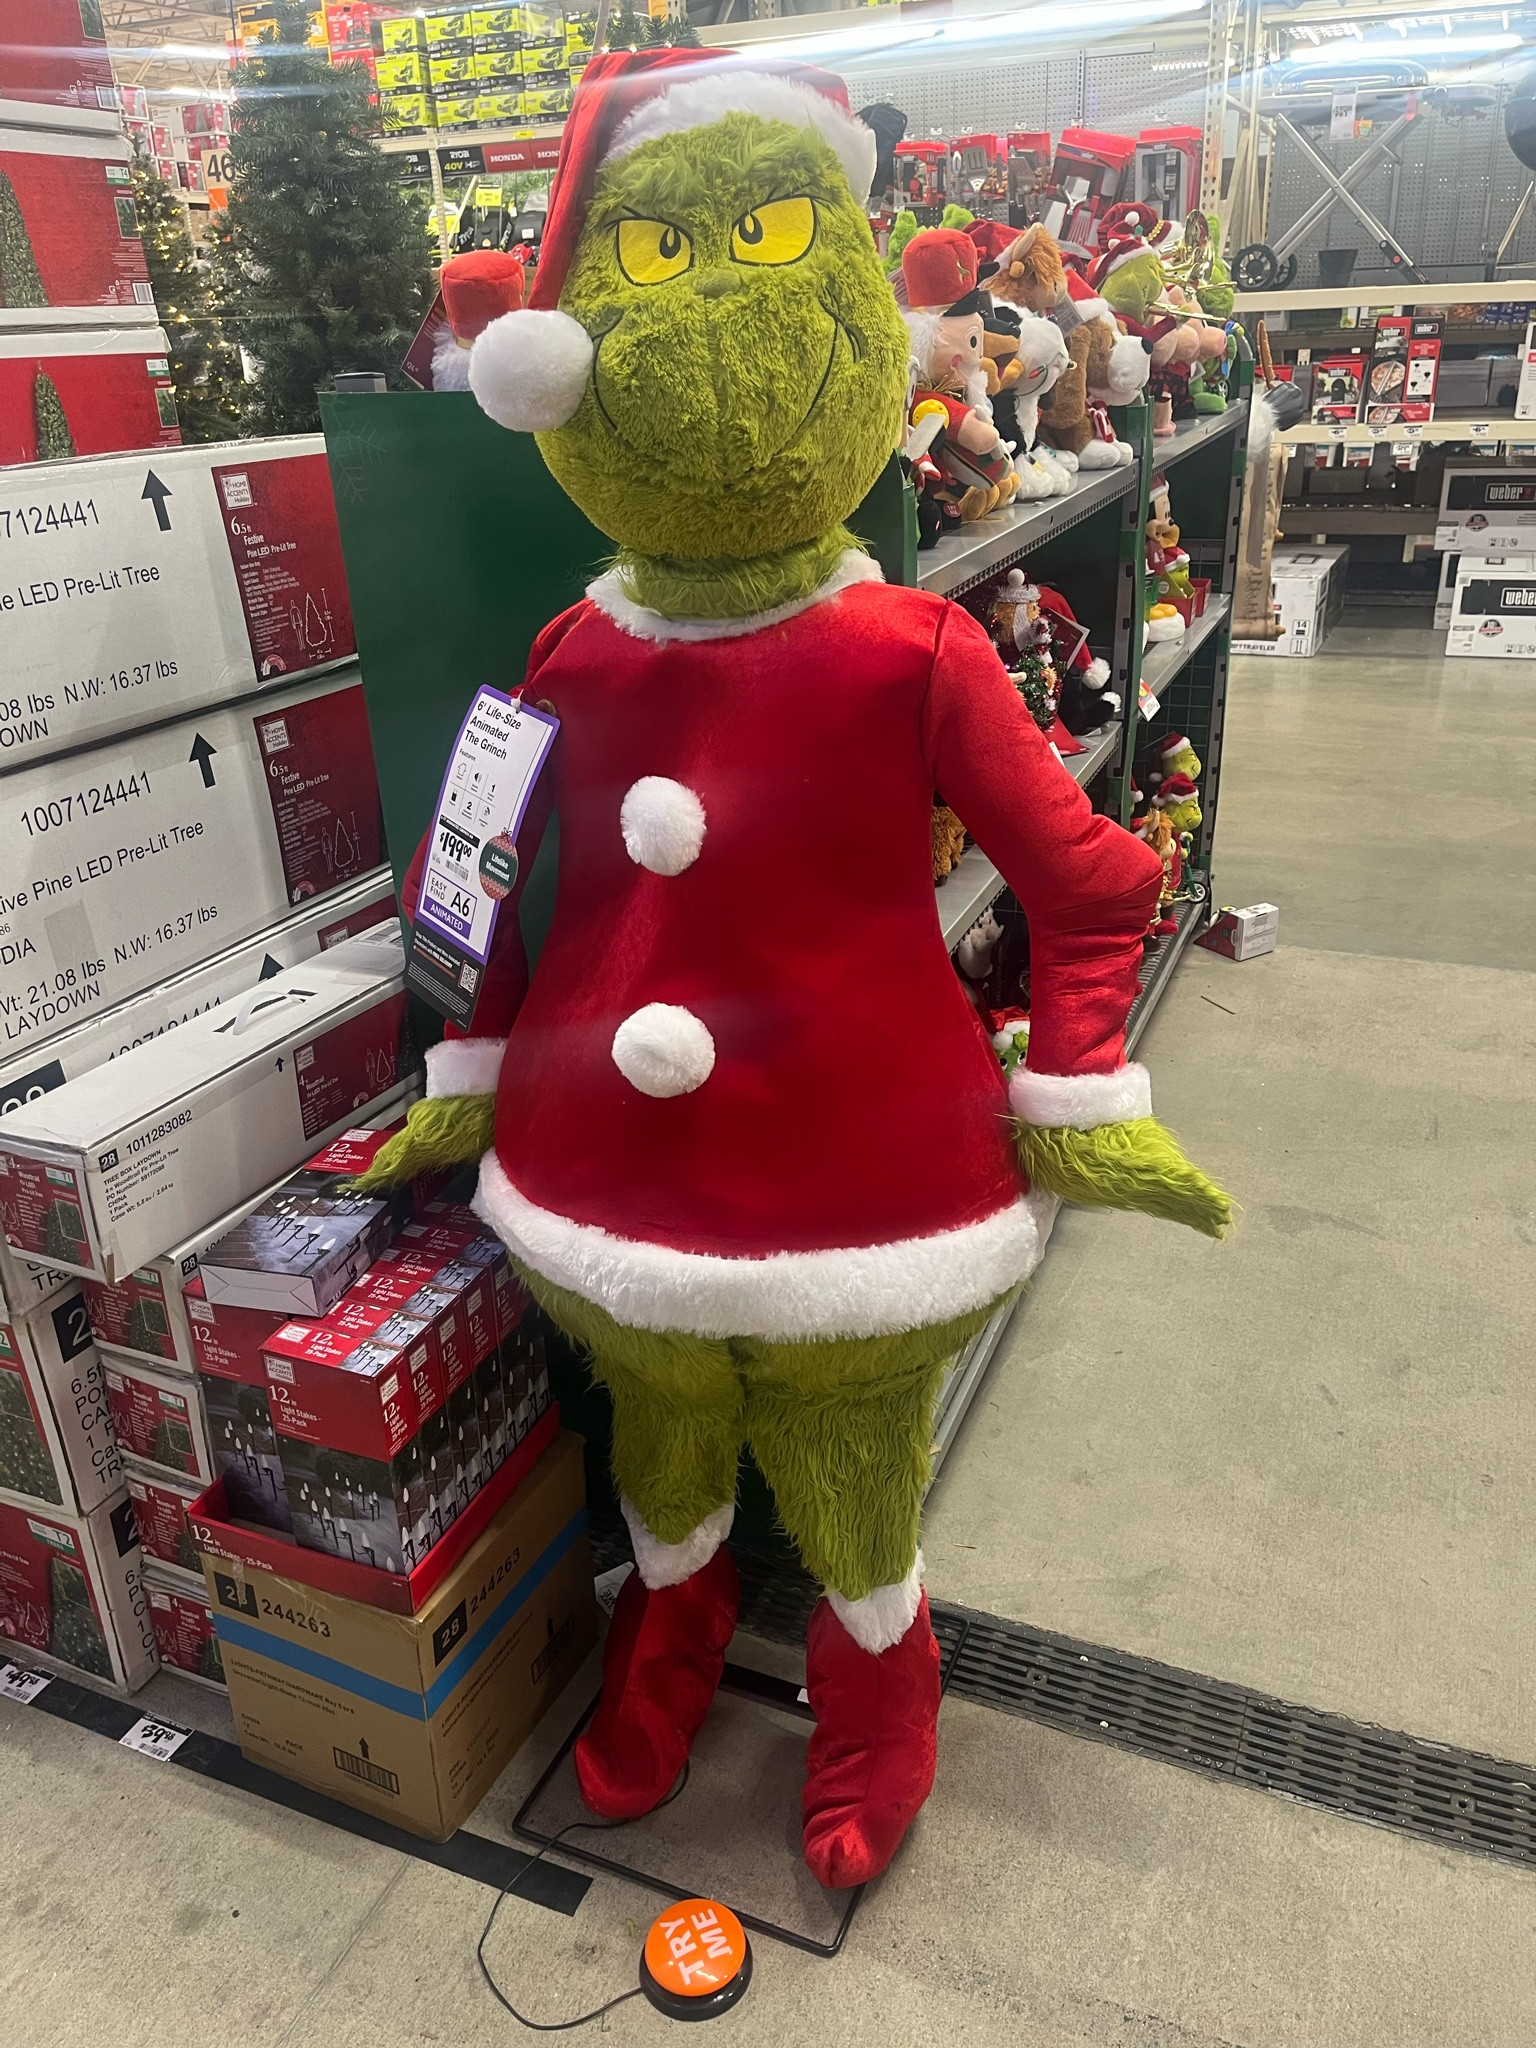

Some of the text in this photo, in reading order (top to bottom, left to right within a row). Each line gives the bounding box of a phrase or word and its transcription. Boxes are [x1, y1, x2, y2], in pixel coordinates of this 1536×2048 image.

[450, 150, 470, 159] RYOBI
[490, 153, 525, 163] HONDA
[538, 150, 560, 159] HON
[119, 167, 128, 178] T4
[207, 154, 235, 182] 46
[444, 161, 463, 170] 40V
[160, 360, 168, 370] T4
[232, 480, 248, 489] HOME
[1489, 483, 1523, 500] weber
[226, 488, 249, 497] ACCENTS
[0, 499, 99, 538] 7124441
[244, 532, 265, 546] Festive
[257, 546, 270, 556] LED
[18, 566, 160, 607] LED Pre-Lit Tree
[1296, 620, 1307, 629] 14
[27, 694, 55, 714] lbs
[64, 677, 106, 704] N.W:
[110, 664, 151, 691] 16.37
[155, 661, 178, 679] lbs
[485, 705, 522, 730] Life-Size
[0, 717, 49, 747] OWN
[271, 726, 285, 734] HOME
[469, 716, 510, 742] Animated
[266, 733, 287, 743] ACCENTS
[464, 729, 508, 760] The Grinch
[281, 772, 300, 786] Festive
[293, 783, 305, 793] LED
[21, 771, 151, 836] 1007124441
[466, 801, 473, 811] 2
[32, 874, 73, 900] Pine
[76, 855, 113, 883] LED
[117, 833, 169, 867] Pre-Lit
[170, 822, 204, 844] Tree
[491, 853, 509, 869] Lifelike
[485, 861, 510, 882] Movement
[431, 877, 447, 892] EASY
[430, 887, 445, 901] FIND
[450, 891, 471, 917] A6
[430, 903, 463, 931] ANIMATED
[27, 906, 218, 1005] 21.08 lbs N.W: 16.37 lbs
[5, 980, 100, 1040] LAYDOWN
[126, 1109, 193, 1155] 1011283082
[326, 1142, 350, 1153] 12
[101, 1153, 116, 1169] 28
[103, 1149, 161, 1186] TREE BOX LAYDOWN
[114, 1171, 141, 1189] Woodtrail
[149, 1154, 168, 1168] Pre-Lit
[167, 1148, 179, 1157] Tree
[106, 1179, 140, 1201] PO Number:
[107, 1194, 127, 1208] CHINA
[114, 1202, 128, 1212] Pack
[111, 1210, 126, 1222] Case
[183, 1257, 196, 1273] 28
[402, 1252, 421, 1264] 12
[372, 1277, 393, 1290] 12
[368, 1293, 389, 1302] 25-Pack
[372, 1287, 403, 1299] Light Stakes
[342, 1303, 364, 1316] 12
[337, 1320, 359, 1330] 25-Pack
[342, 1314, 374, 1327] Light Stakes
[192, 1324, 212, 1343] 12
[310, 1331, 332, 1345] 12
[203, 1343, 237, 1358] Light Stakes
[304, 1348, 327, 1358] 25-Pack
[311, 1343, 342, 1356] Light Stakes
[206, 1353, 229, 1365] 25-Pack
[268, 1366, 292, 1376] ACCENTS
[275, 1362, 290, 1372] HOME
[268, 1384, 290, 1404] 12
[280, 1404, 318, 1421] Light Stakes
[383, 1402, 396, 1424] 12
[282, 1414, 307, 1427] 25-Pack
[52, 1529, 73, 1546] T2
[191, 1524, 214, 1545] 12
[203, 1543, 220, 1555] Light
[246, 1557, 274, 1571] 25-Pack
[441, 1546, 521, 1649] 28 244263
[261, 1598, 331, 1637] 244263
[691, 1908, 733, 1960] ME
[658, 1917, 705, 1986] TRY
